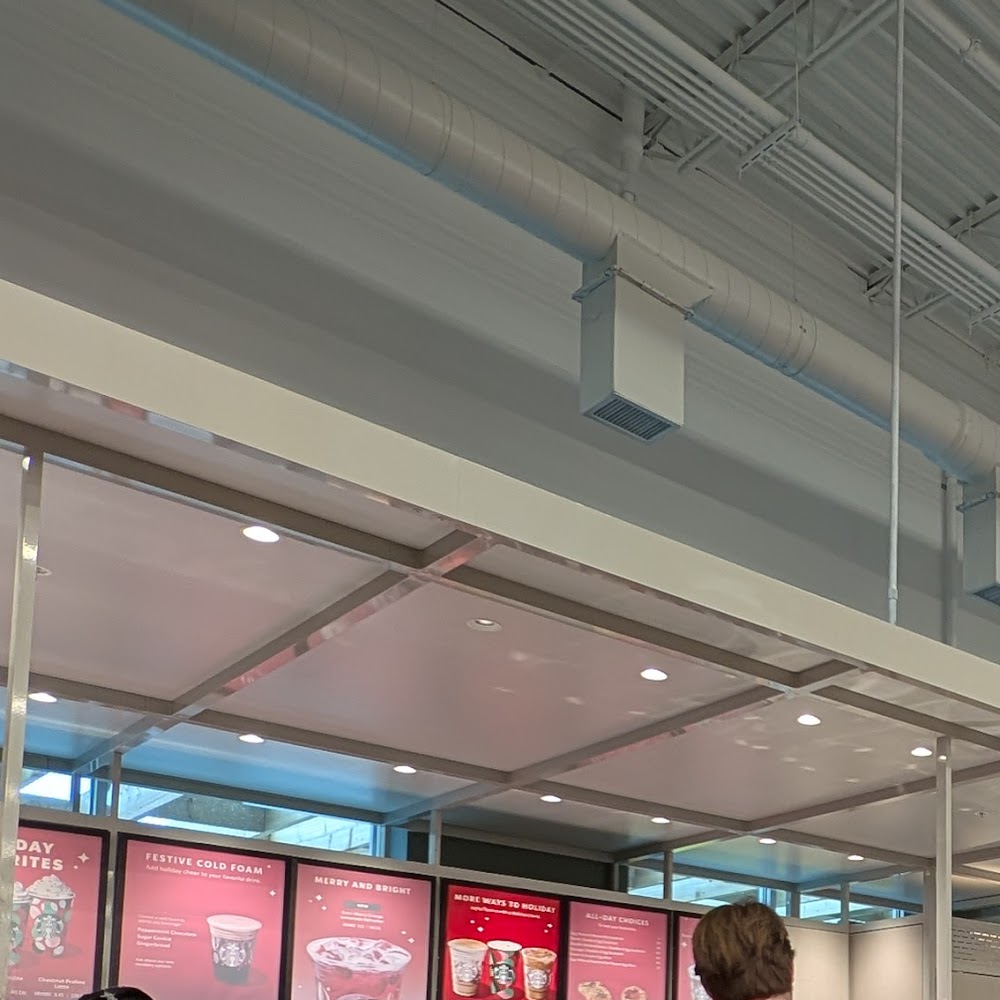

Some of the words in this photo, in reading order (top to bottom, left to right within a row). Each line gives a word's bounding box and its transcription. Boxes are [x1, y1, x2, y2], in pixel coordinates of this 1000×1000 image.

[145, 852, 193, 866] FESTIVE
[196, 859, 227, 870] COLD
[230, 863, 263, 875] FOAM
[159, 865, 183, 875] holiday
[314, 876, 349, 888] MERRY
[351, 881, 373, 890] AND
[375, 884, 411, 895] BRIGHT
[453, 894, 480, 903] MORE
[482, 897, 507, 907] WAYS
[508, 901, 520, 909] TO
[521, 902, 556, 914] HOLIDAY
[585, 912, 618, 923] ALL-DAY
[619, 916, 650, 926] CHOICES
